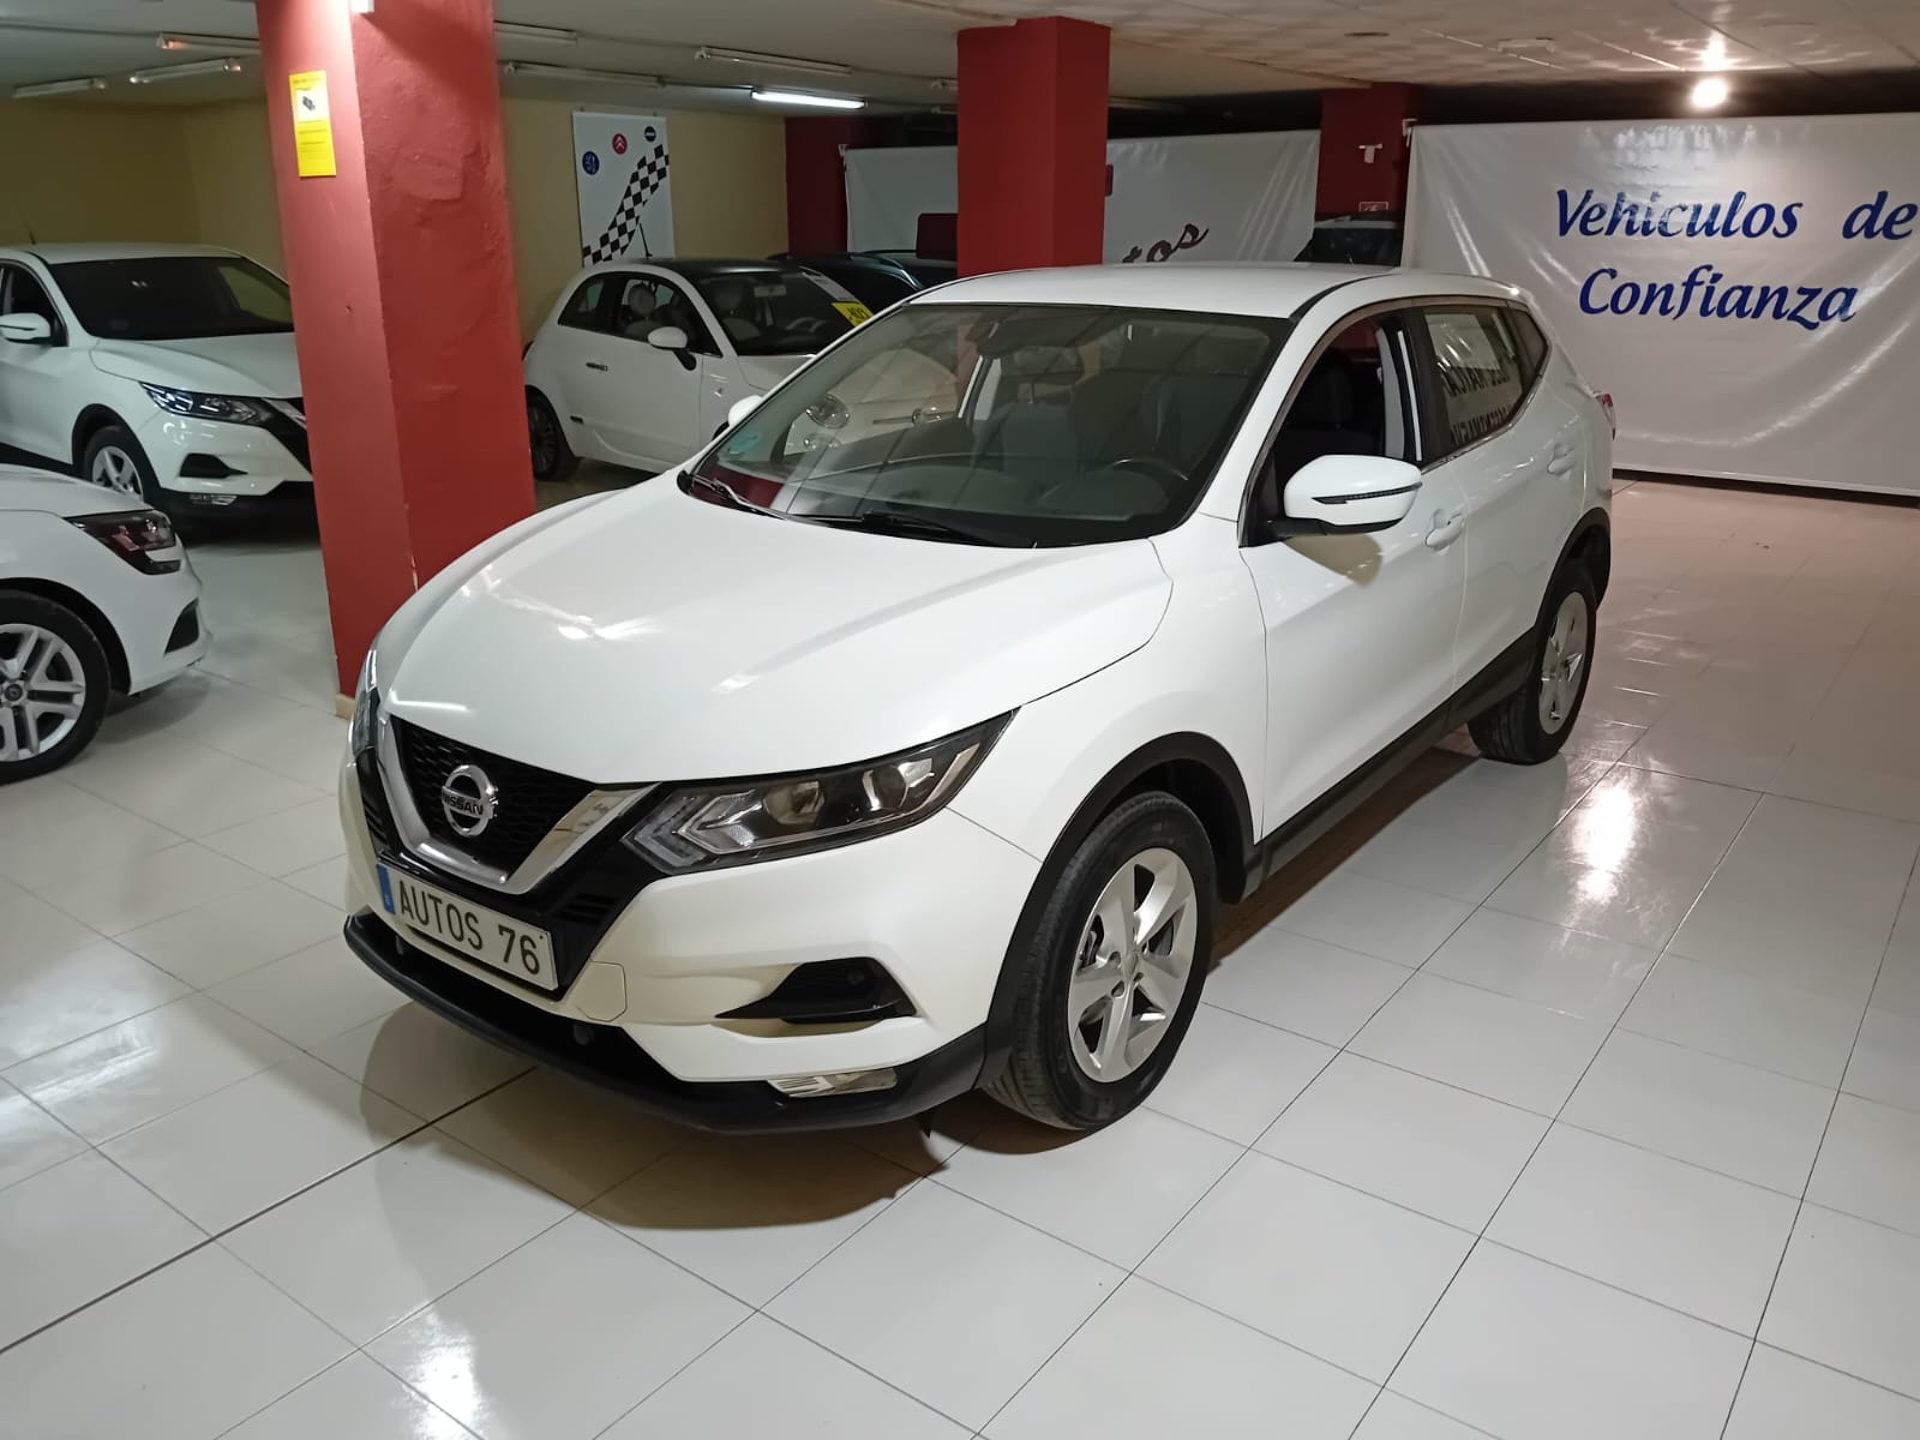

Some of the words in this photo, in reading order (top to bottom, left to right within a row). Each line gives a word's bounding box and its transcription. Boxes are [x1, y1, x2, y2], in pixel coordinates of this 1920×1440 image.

[1556, 189, 1803, 238] Vehiculos
[1842, 190, 1918, 240] de
[1579, 264, 1858, 331] Confianza
[442, 793, 484, 817] NISSAN
[399, 879, 483, 951] AUTOS
[498, 924, 541, 976] 76
